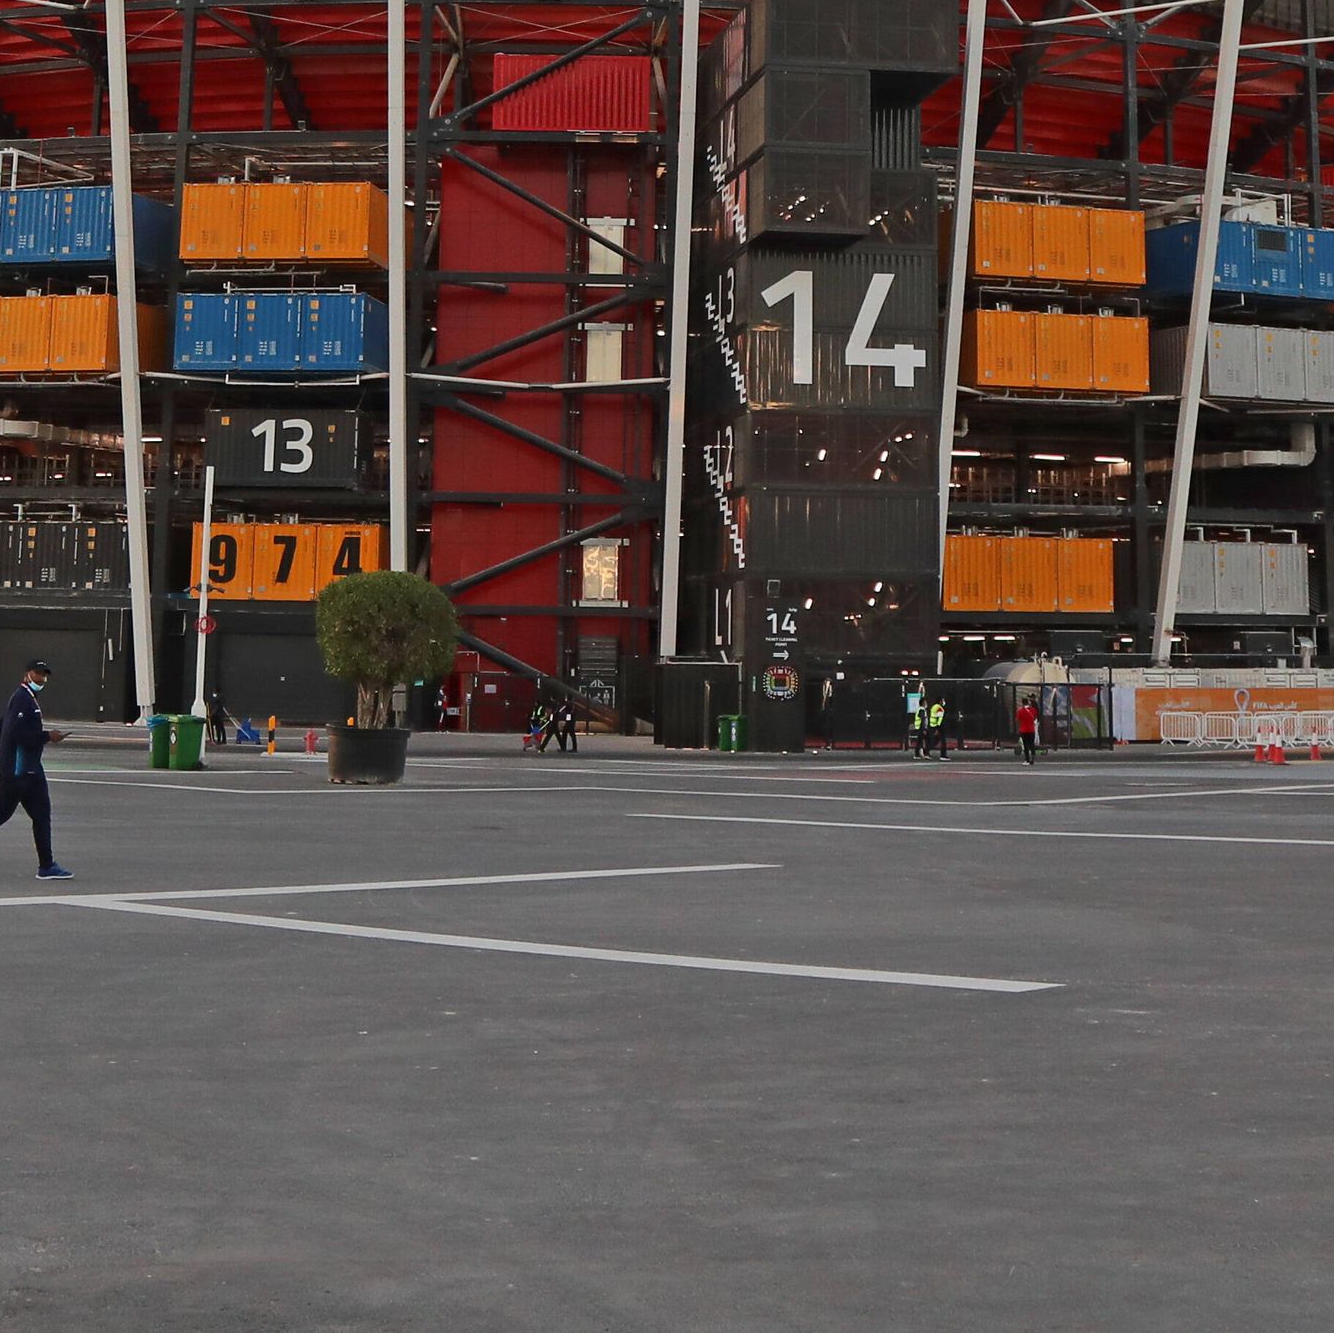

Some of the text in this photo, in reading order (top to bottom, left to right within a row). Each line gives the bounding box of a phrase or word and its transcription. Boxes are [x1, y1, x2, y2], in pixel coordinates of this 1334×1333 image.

[715, 266, 734, 324] L3
[761, 270, 926, 388] 14
[251, 418, 314, 474] 13
[714, 425, 733, 484] L2
[766, 612, 798, 635] 14
